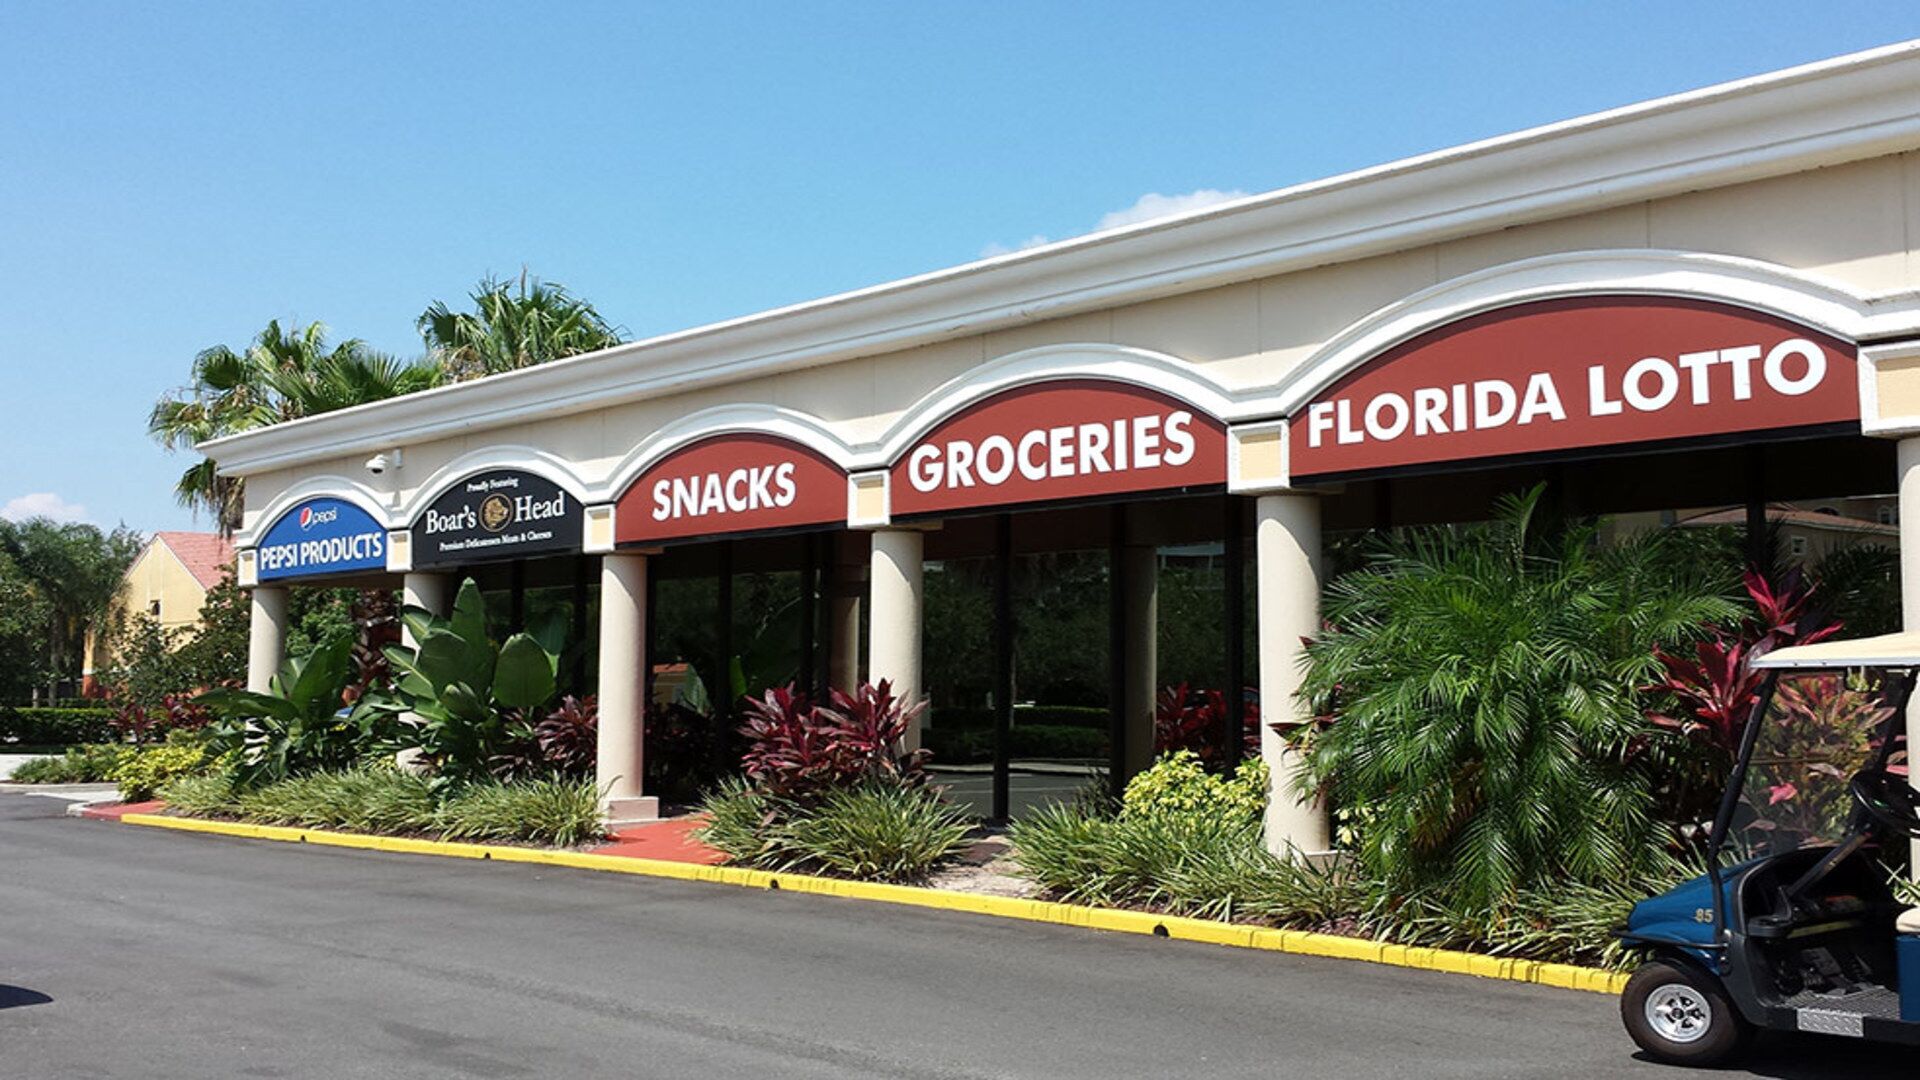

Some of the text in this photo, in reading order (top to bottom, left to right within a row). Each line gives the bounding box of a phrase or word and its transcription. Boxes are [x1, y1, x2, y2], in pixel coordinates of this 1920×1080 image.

[1308, 338, 1827, 448] FLORIDA LOTTO
[908, 410, 1196, 492] GROCERIES
[425, 491, 565, 534] Boar's Head
[652, 462, 796, 521] SNACKS
[312, 506, 338, 526] pepsi
[260, 532, 383, 571] PEPSI PRODUCTS
[1695, 908, 1713, 923] 85
